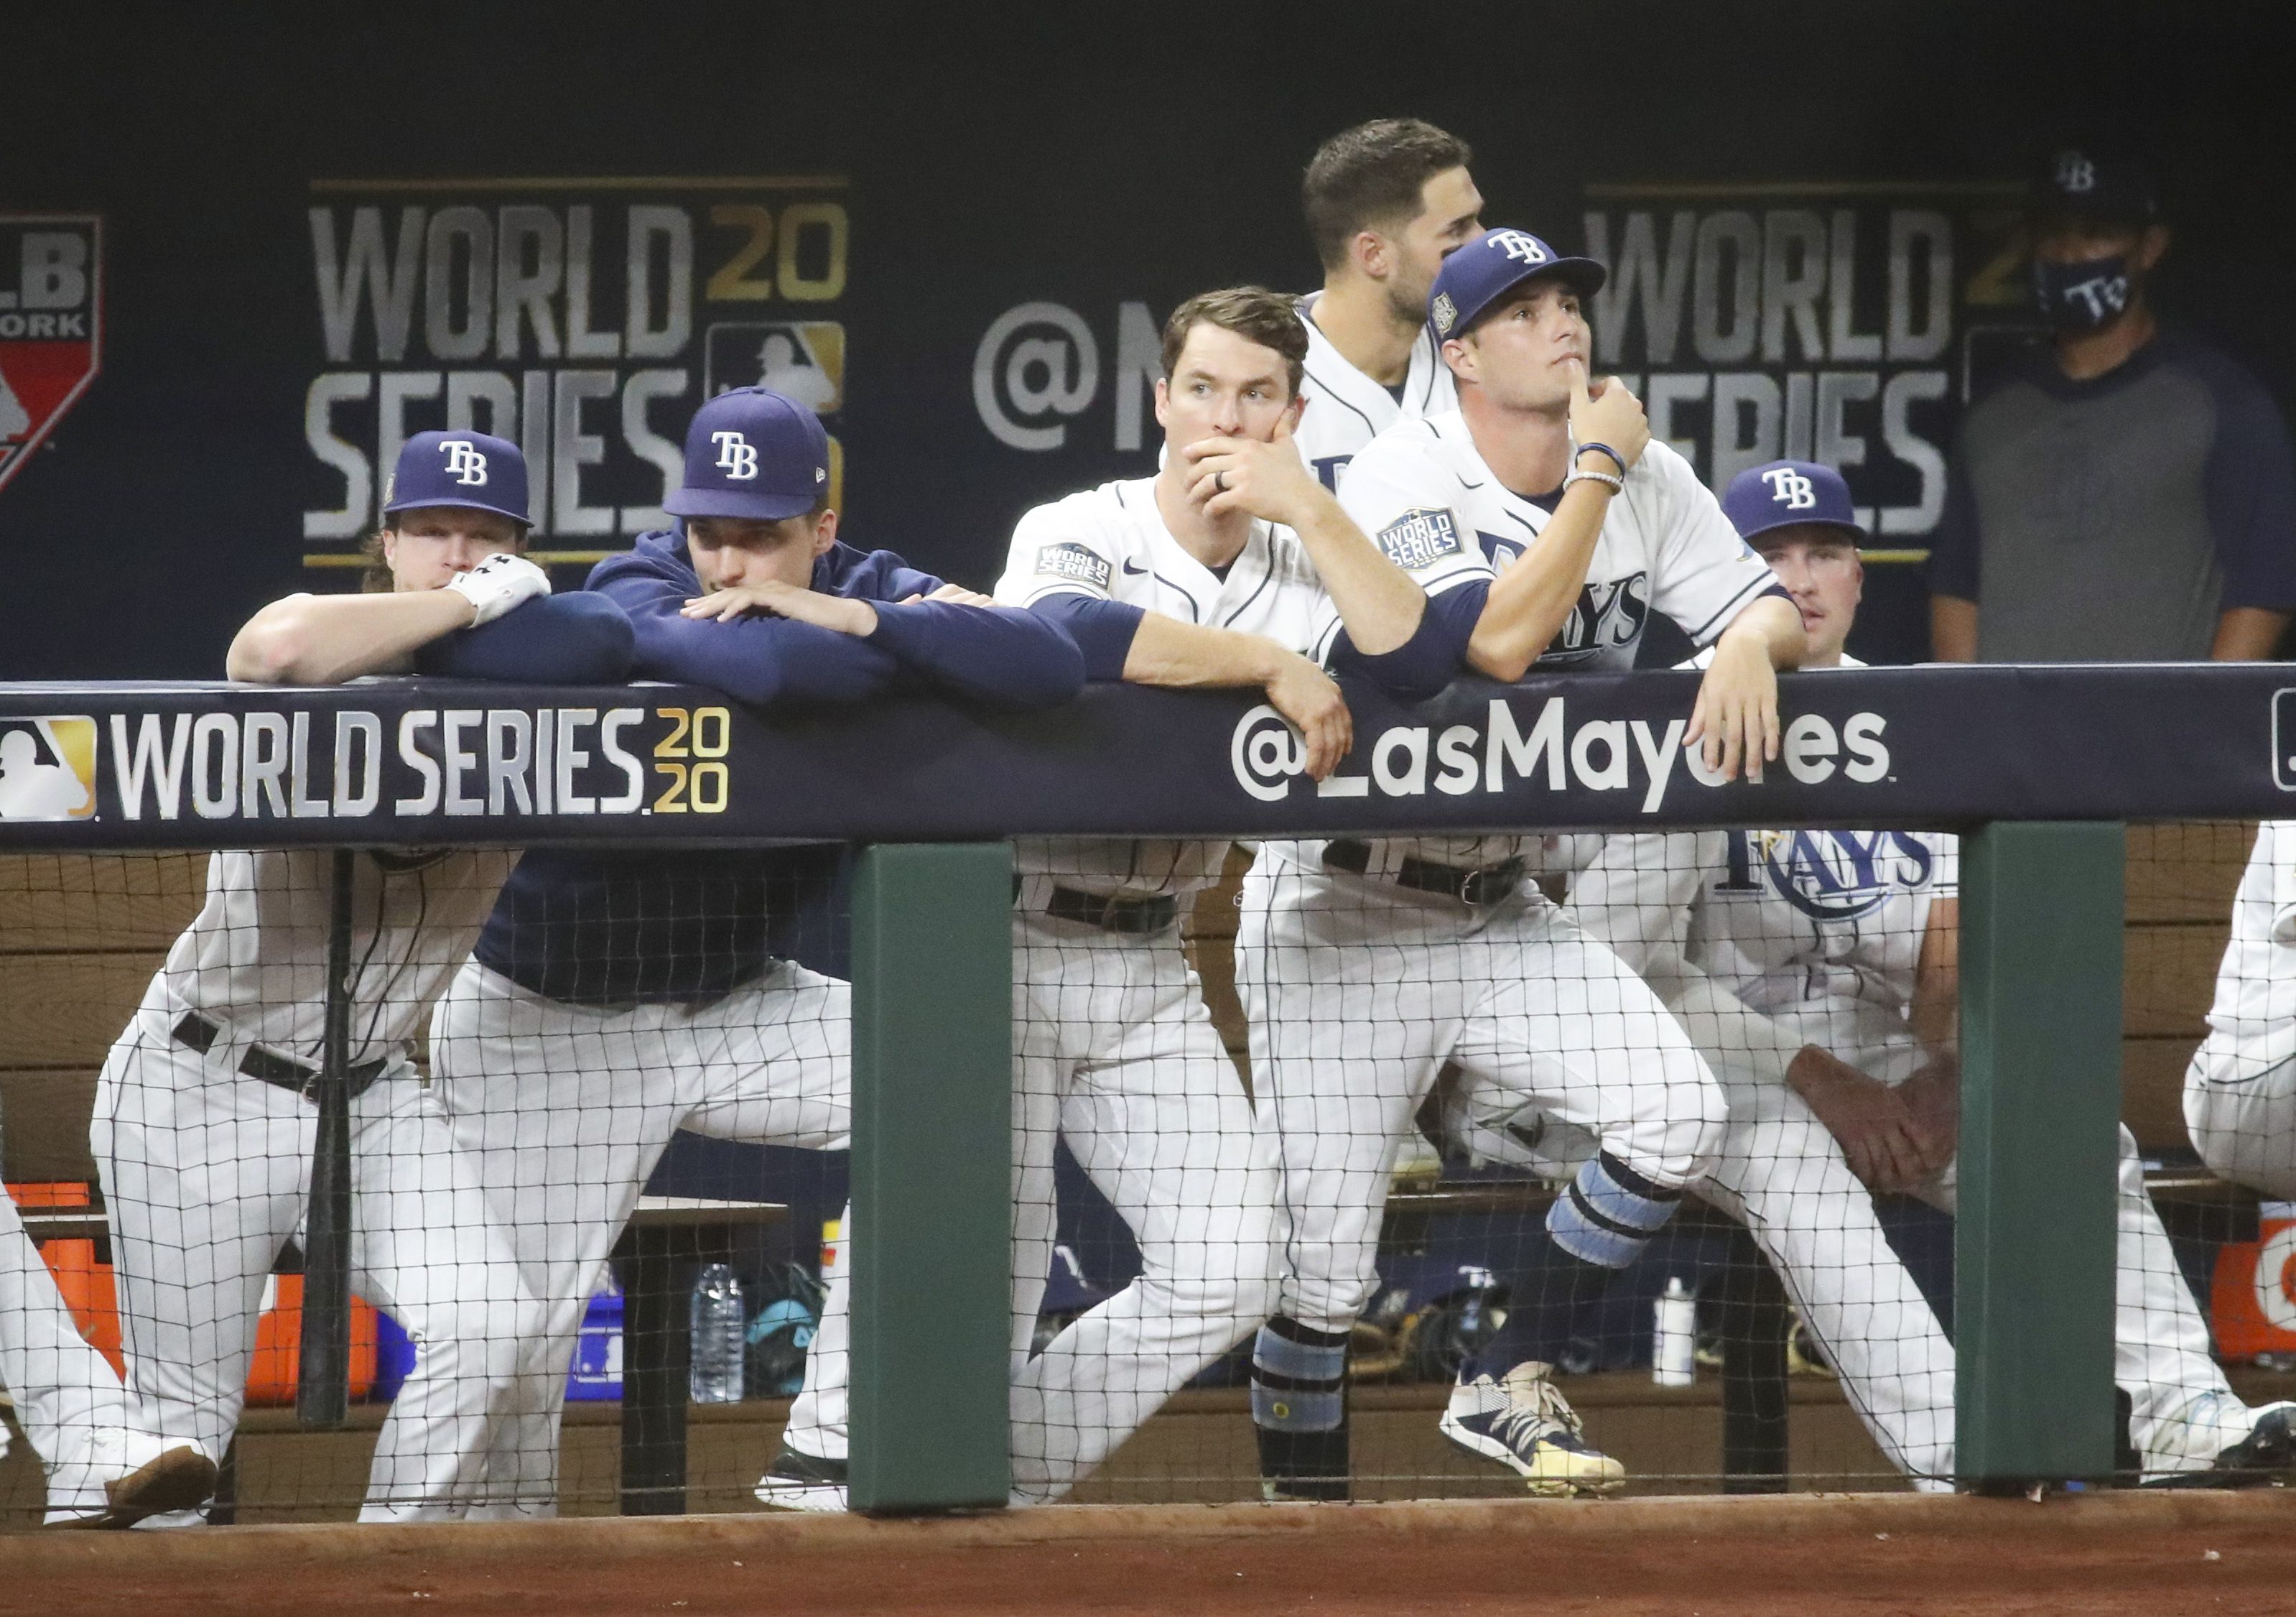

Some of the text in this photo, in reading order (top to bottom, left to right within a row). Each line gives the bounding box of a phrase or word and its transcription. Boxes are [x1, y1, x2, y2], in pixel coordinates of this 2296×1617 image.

[706, 203, 849, 300] 20
[1487, 230, 1547, 264] TB
[307, 204, 694, 362] WORLD
[1582, 210, 1952, 363] WORLD
[438, 440, 488, 487] TB
[710, 431, 758, 481] TB
[1762, 467, 1817, 510] TB
[1382, 514, 1451, 550] WORLD
[1388, 530, 1456, 567] SERIES
[1038, 560, 1109, 586] SERIES
[1041, 548, 1110, 575] WORLD
[654, 706, 730, 758] 20
[109, 707, 645, 821] WORLD SERIES
[654, 762, 728, 813] 20
